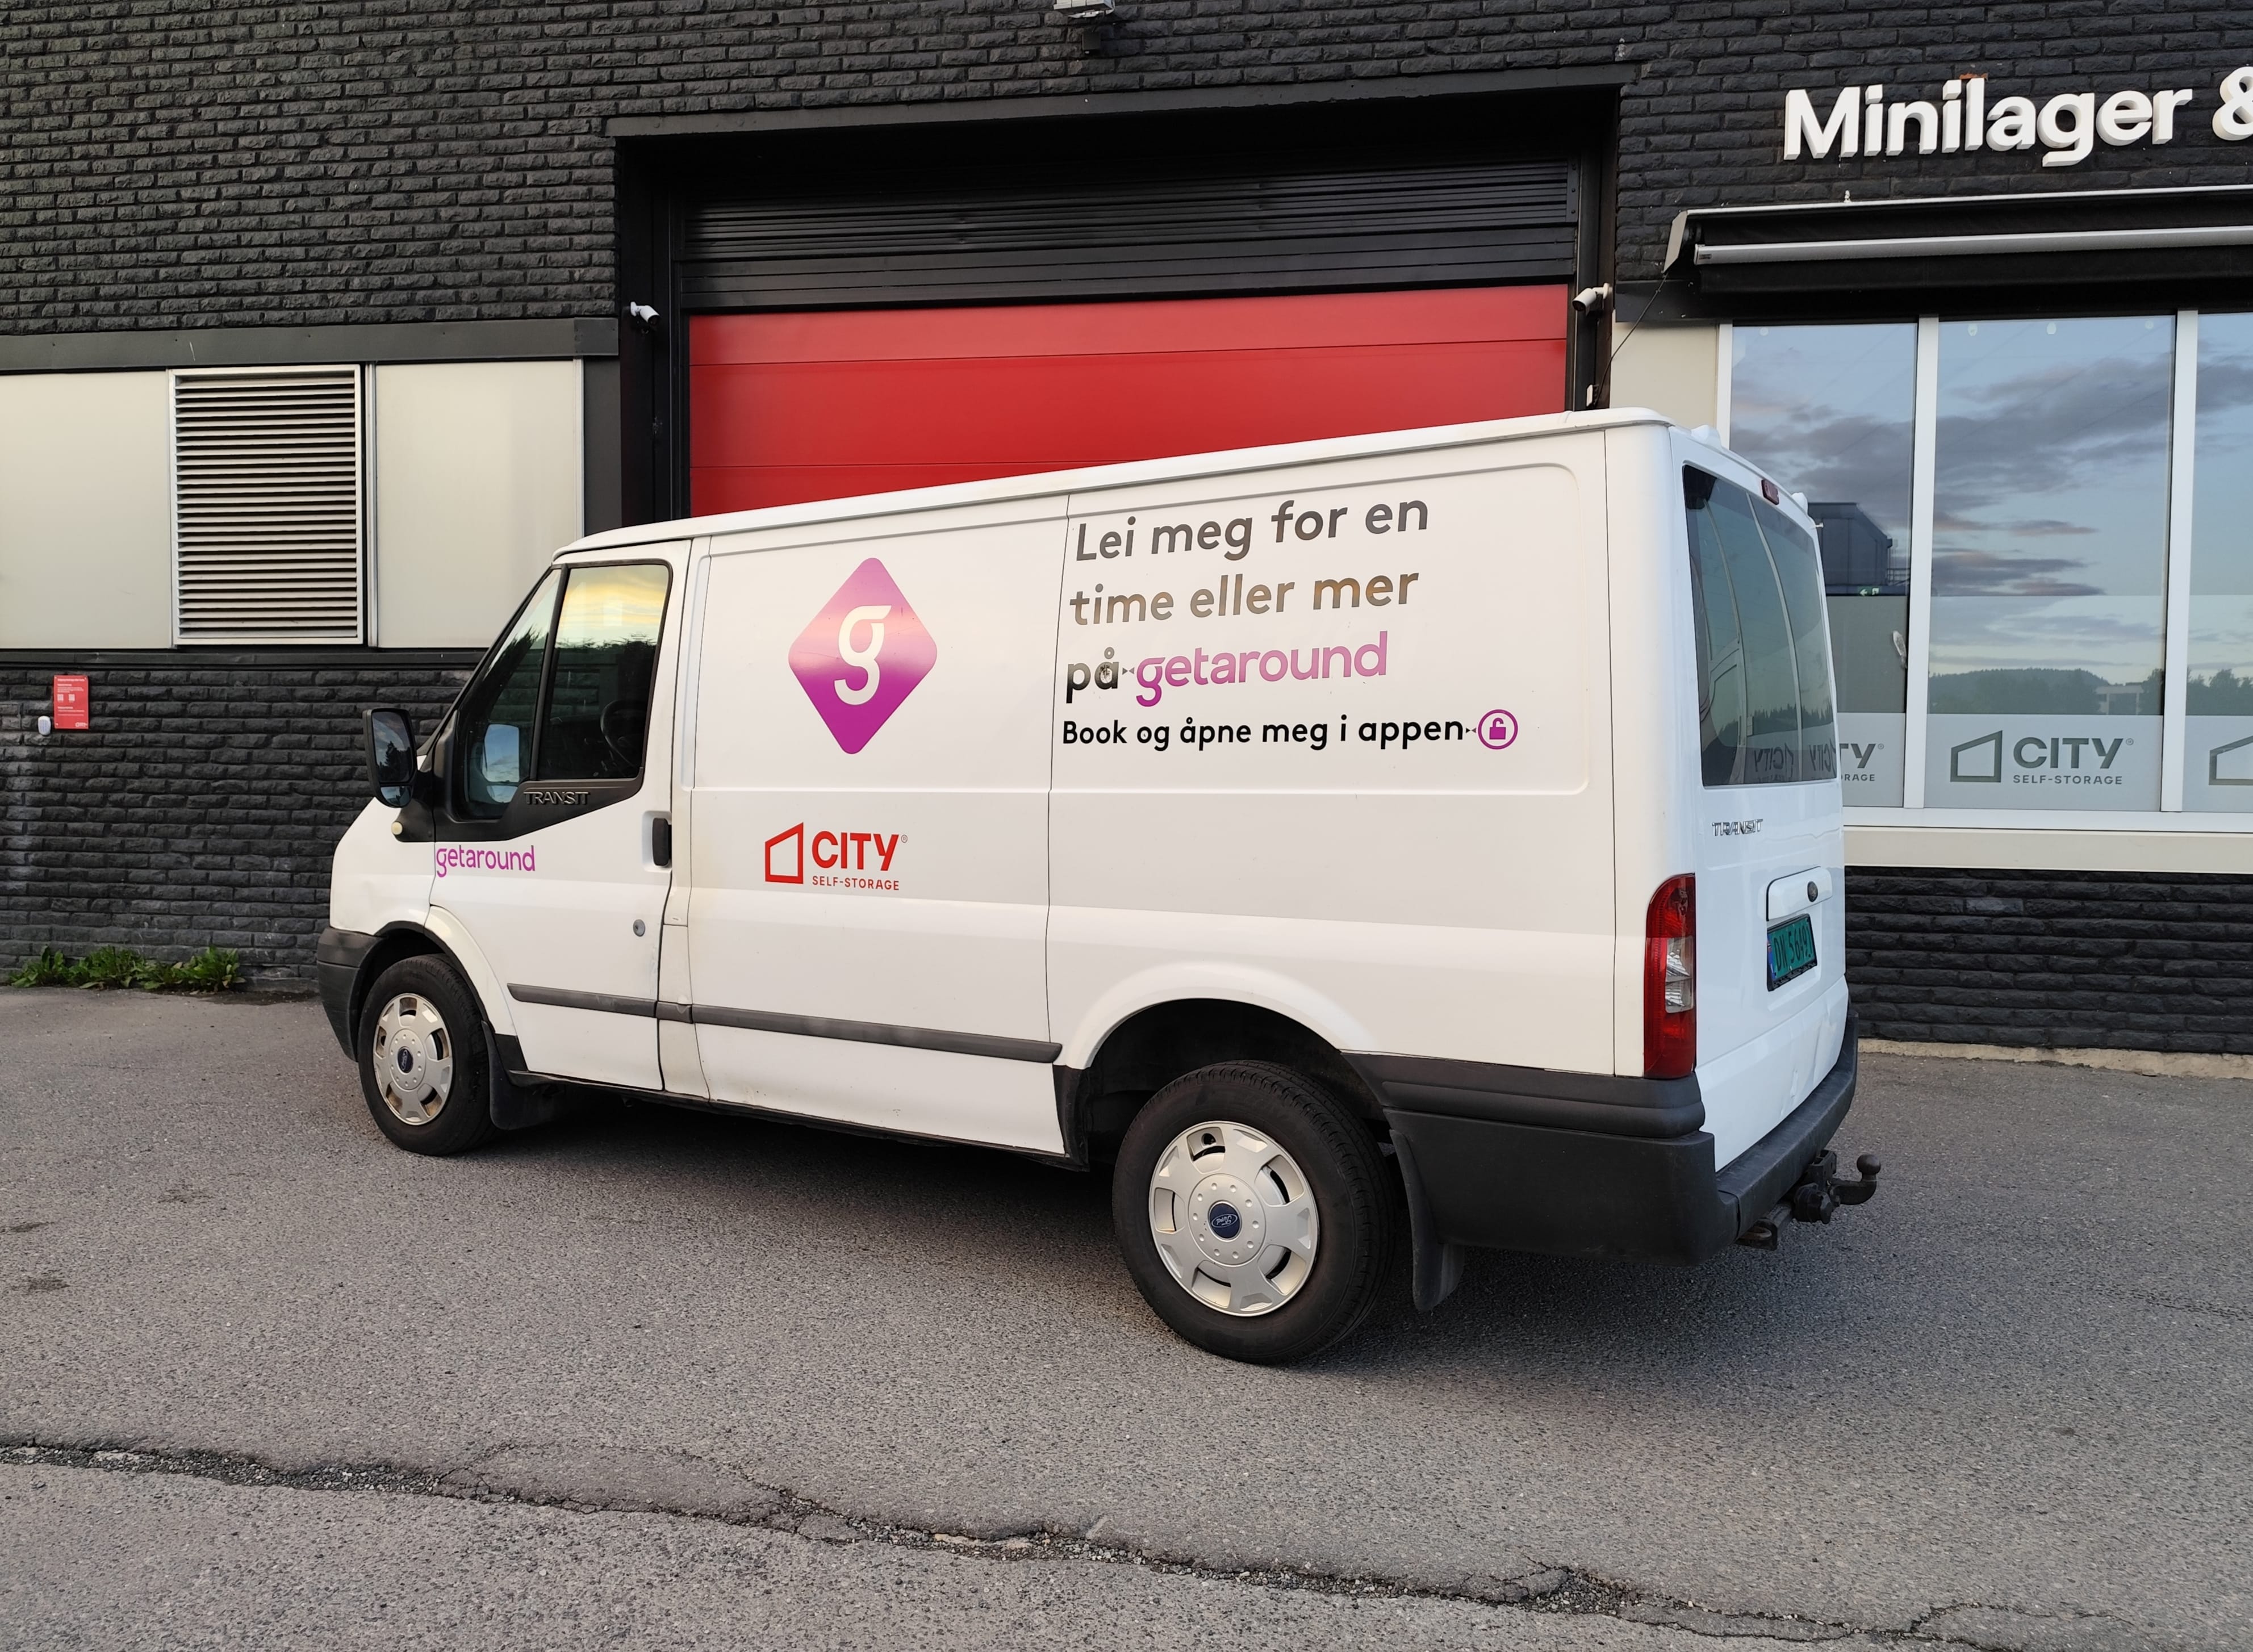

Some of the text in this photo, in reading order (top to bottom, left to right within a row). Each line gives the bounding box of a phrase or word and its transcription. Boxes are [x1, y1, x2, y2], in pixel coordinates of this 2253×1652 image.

[1784, 77, 2192, 167] Minilager
[1076, 500, 1428, 562] Lei meg for en
[1069, 572, 1419, 625] time eller mer
[1066, 631, 1388, 708] på getaround
[1063, 714, 1464, 752] Book og åpne meg i appen
[523, 791, 590, 805] TRANSIT
[2013, 775, 2122, 785] SELF-STORAGE
[436, 845, 536, 877] getaround
[812, 875, 899, 890] SELF-STORAGE
